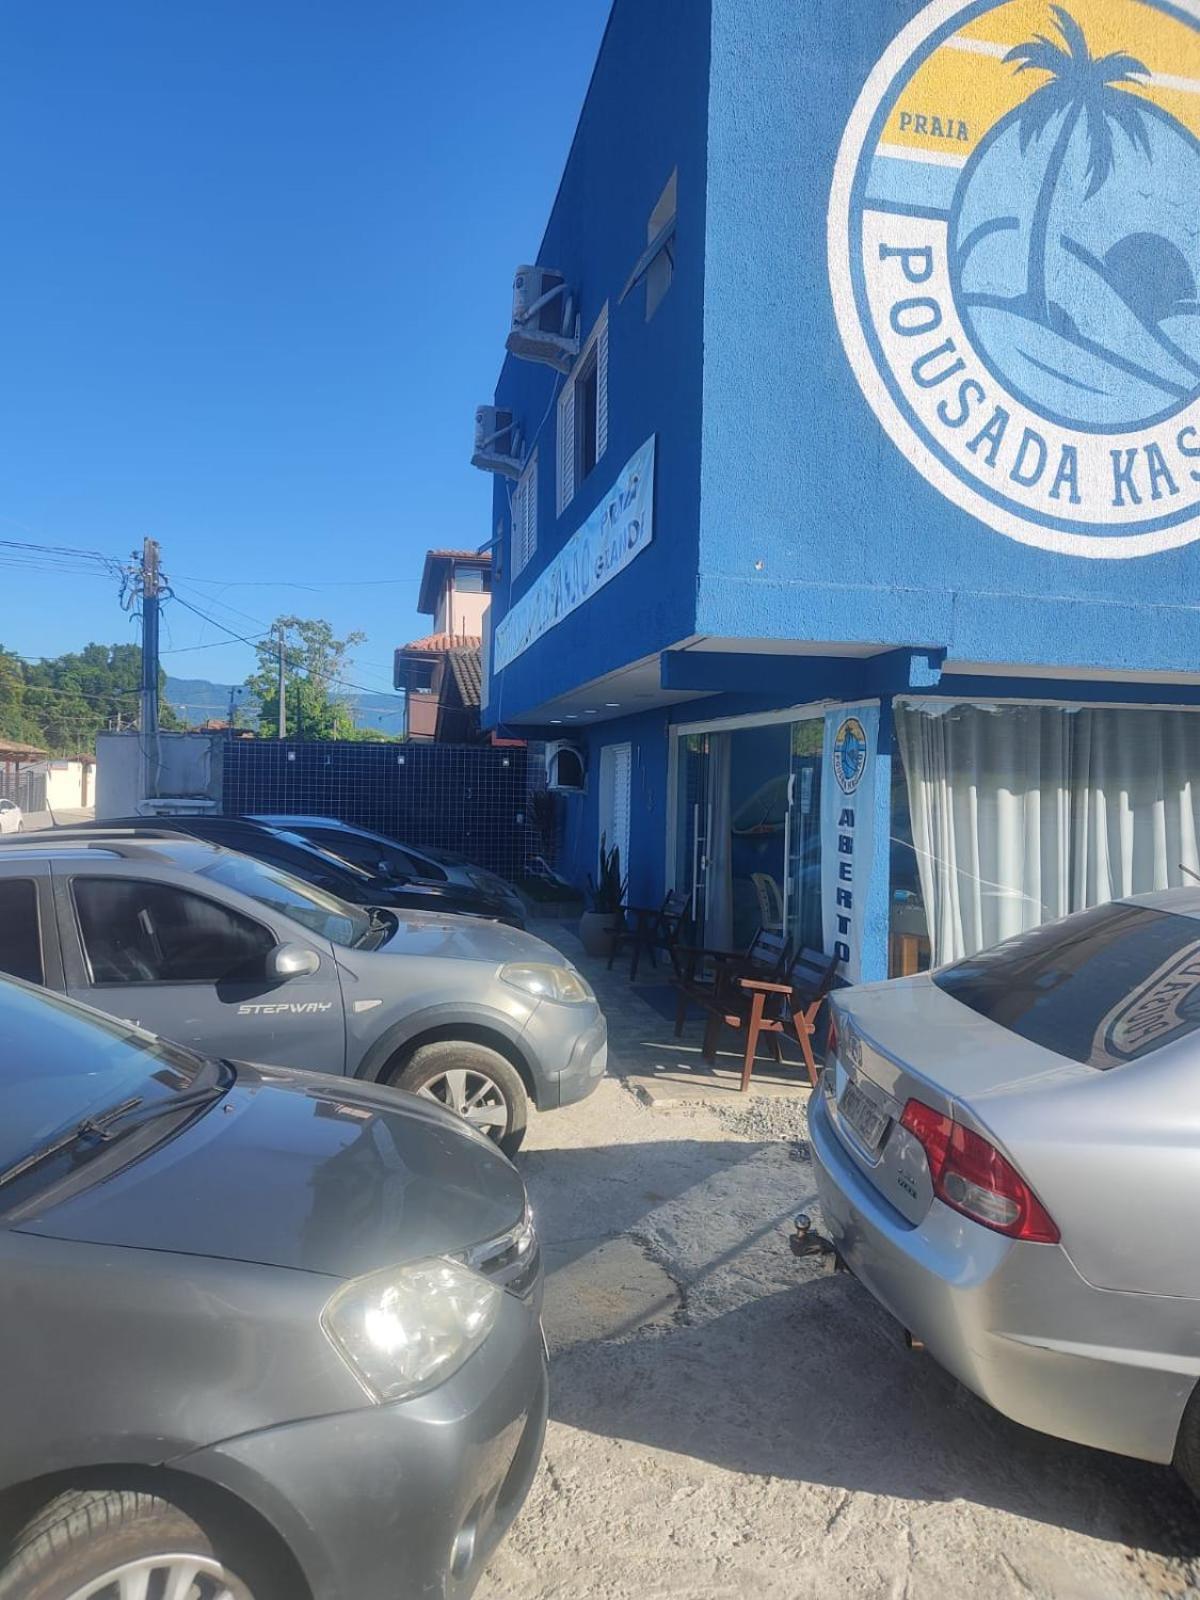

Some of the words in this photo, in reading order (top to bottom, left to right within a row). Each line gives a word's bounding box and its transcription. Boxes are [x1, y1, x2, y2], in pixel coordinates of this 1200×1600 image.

[899, 110, 970, 142] PRAIA
[878, 243, 1082, 505] POUSADA
[834, 808, 855, 964] ABERTO
[237, 1002, 332, 1015] STEPWAY
